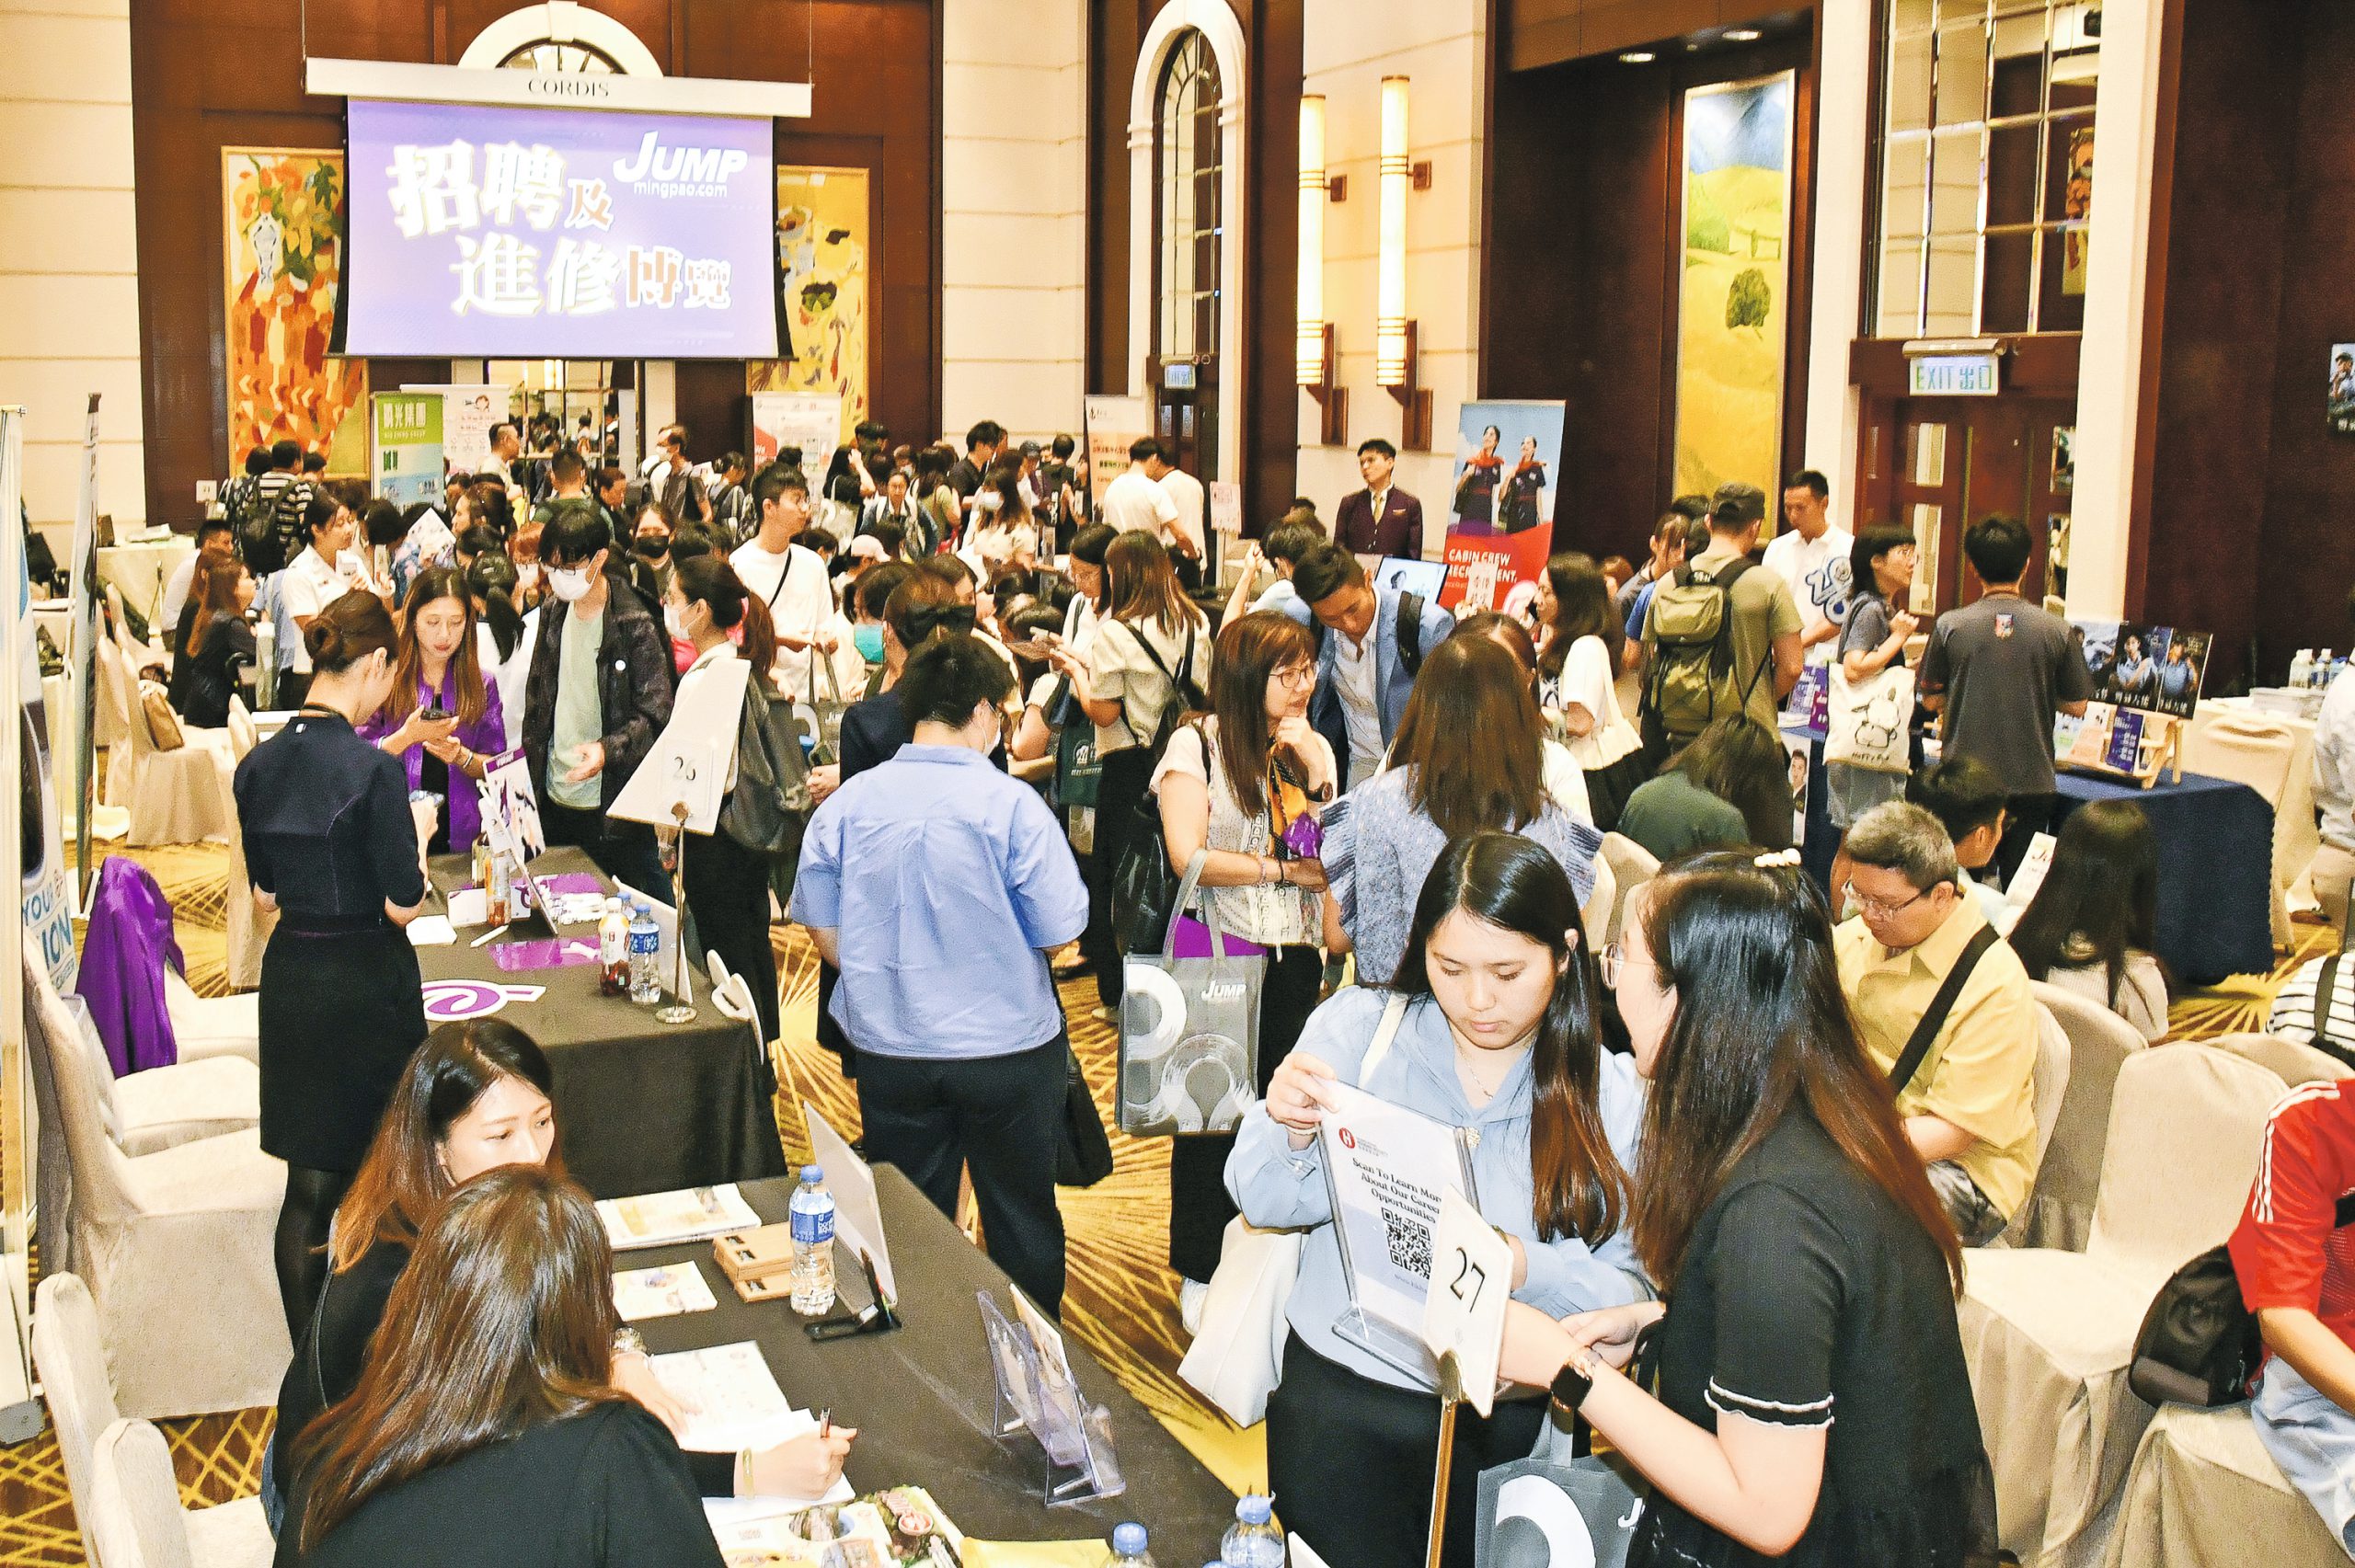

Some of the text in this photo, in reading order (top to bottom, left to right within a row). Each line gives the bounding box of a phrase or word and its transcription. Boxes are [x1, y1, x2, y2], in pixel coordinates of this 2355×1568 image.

[528, 79, 609, 97] CORDIS
[613, 131, 748, 183] JUMP
[385, 138, 615, 240] 招聘及
[634, 179, 728, 199] mingpao.com
[449, 232, 732, 316] 進修博覽
[1916, 365, 1992, 390] EXIT 出口
[1449, 548, 1511, 566] CABIN CREW
[1448, 564, 1518, 584] RECRENT,
[673, 756, 696, 781] 26
[1200, 979, 1247, 1001] JUMP
[1352, 1157, 1442, 1203] Scan To Learn Mor
[1361, 1173, 1389, 1191] About
[1390, 1185, 1408, 1200] Our
[1371, 1187, 1436, 1224] Opportunities
[1449, 1245, 1488, 1314] 27
